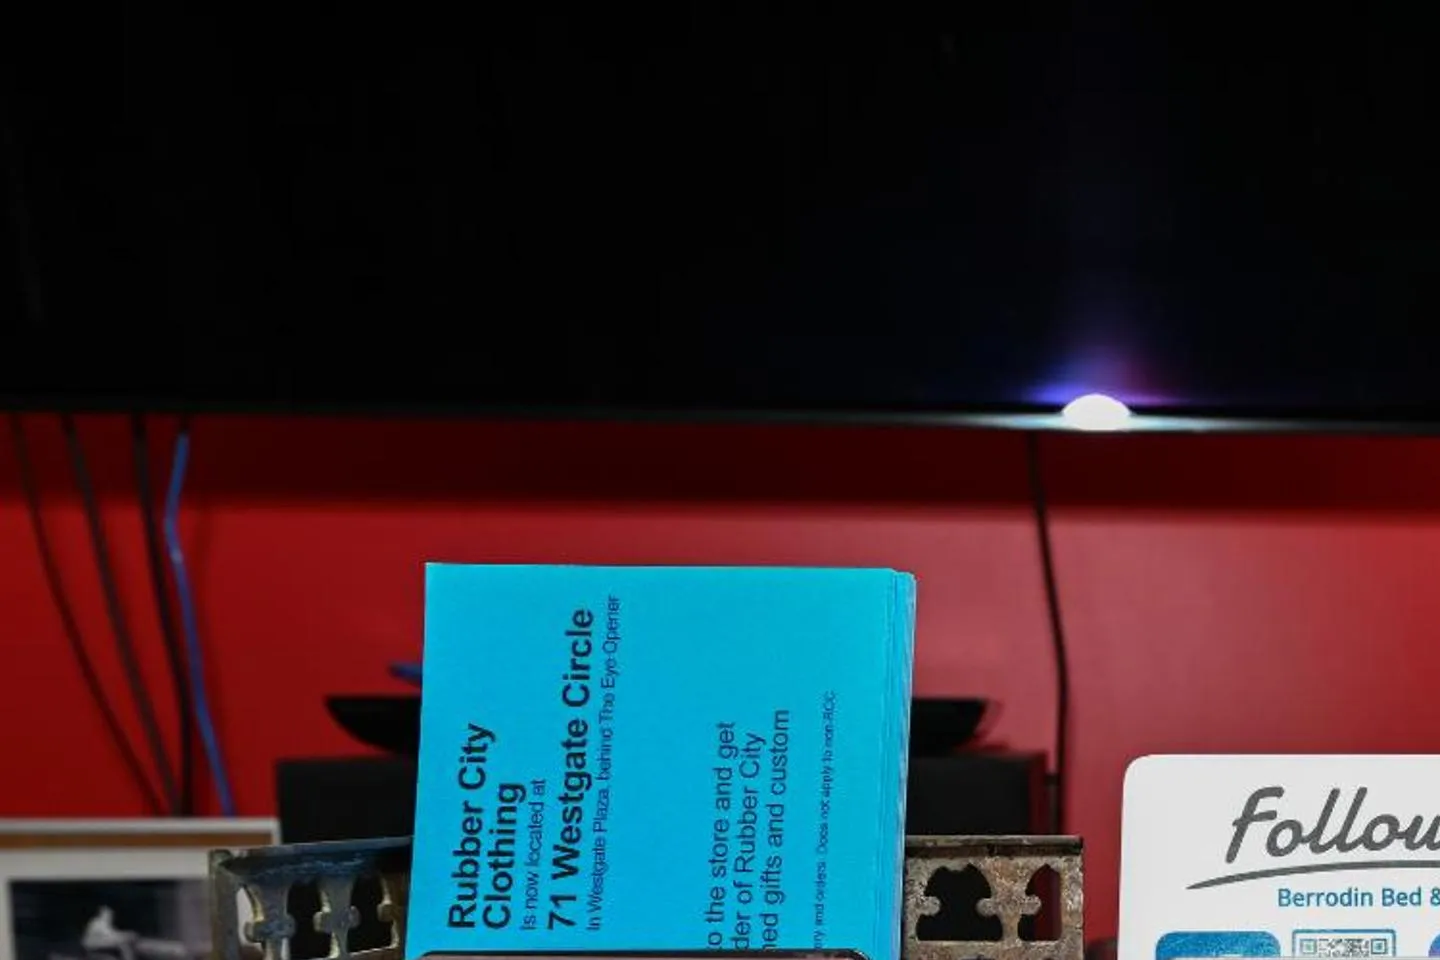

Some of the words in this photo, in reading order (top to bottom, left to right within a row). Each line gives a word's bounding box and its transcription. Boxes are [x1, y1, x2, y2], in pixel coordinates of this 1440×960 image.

[602, 594, 621, 655] Opener
[561, 608, 594, 708] Circle
[599, 692, 616, 724] The
[457, 723, 496, 791] City
[595, 728, 613, 781] behind
[715, 722, 739, 760] get
[738, 732, 767, 779] City
[769, 709, 790, 796] custom
[530, 778, 546, 796] at
[551, 718, 593, 880] Westgate
[712, 766, 733, 810] and
[524, 801, 545, 866] located
[708, 818, 730, 878] store
[734, 786, 759, 873] Rubber
[766, 803, 785, 848] and
[814, 903, 825, 926] and
[820, 765, 834, 798] apply
[447, 800, 484, 929] Rubber
[482, 783, 526, 930] Clothing
[587, 836, 609, 913] Westgate
[760, 854, 786, 905] gifts
[525, 871, 540, 909] now
[547, 894, 577, 930] 71
[704, 886, 727, 923] the
[733, 879, 753, 905] of
[1277, 885, 1374, 908] Berrodin
[1381, 885, 1423, 908] Bed
[587, 917, 602, 931] In
[703, 931, 723, 950] o
[730, 912, 751, 950] der
